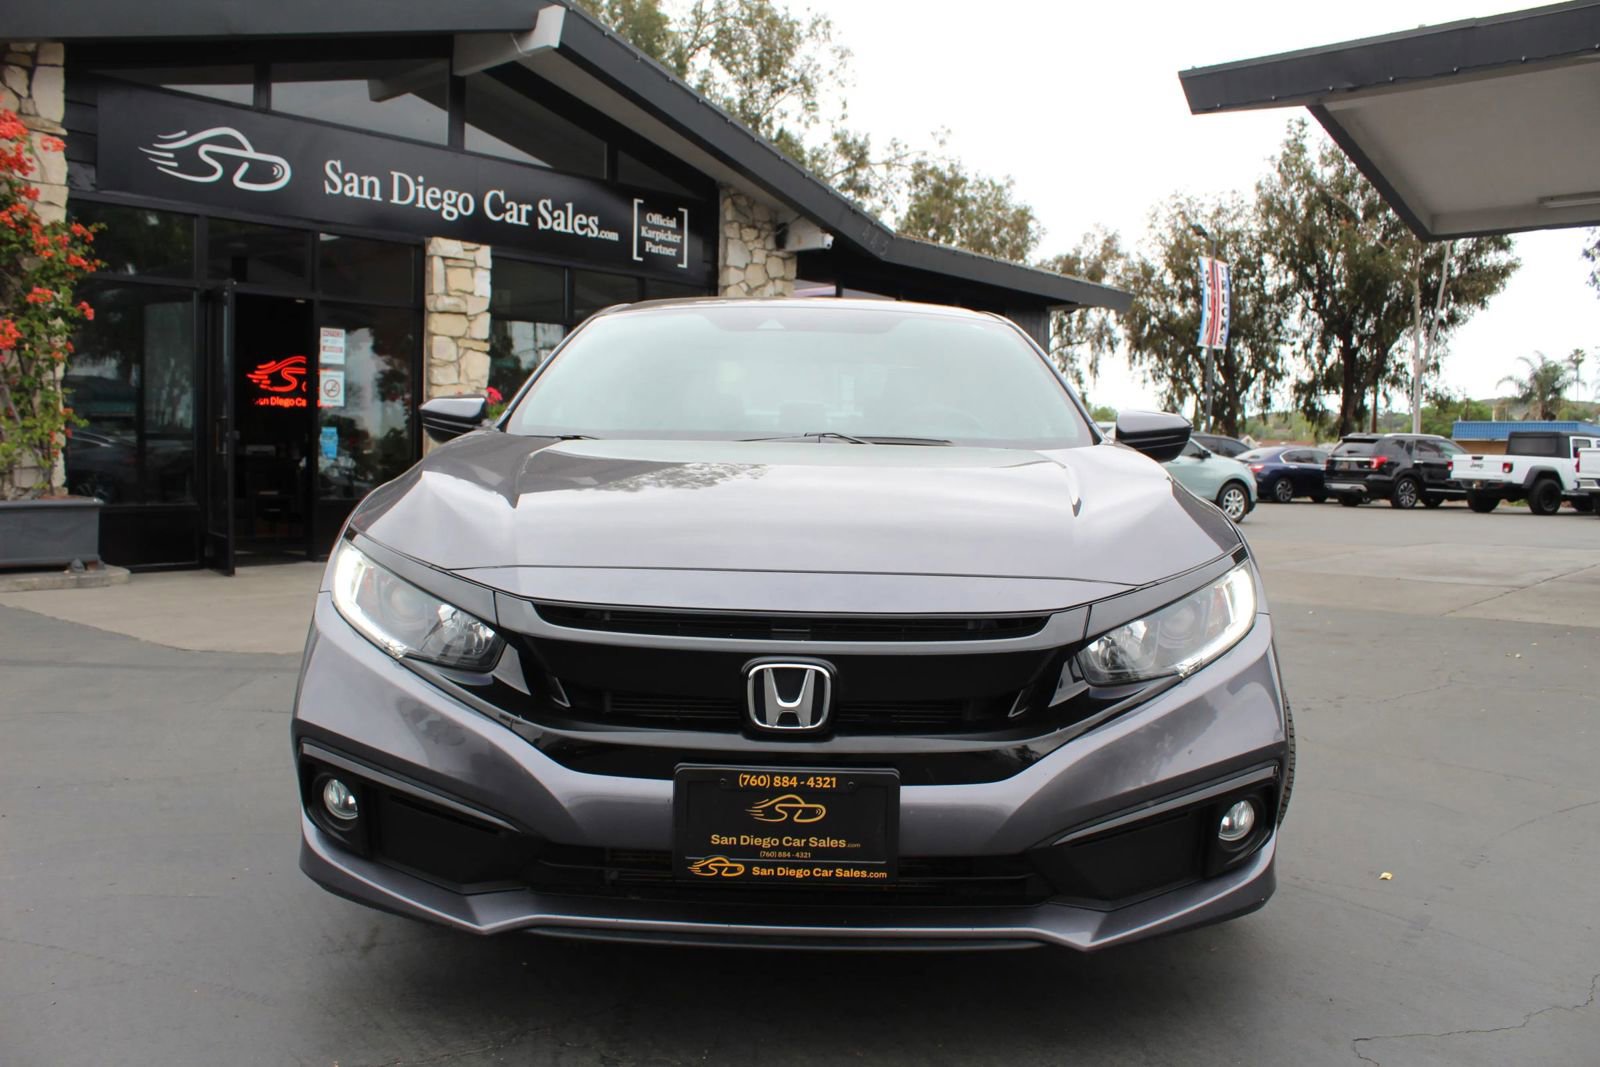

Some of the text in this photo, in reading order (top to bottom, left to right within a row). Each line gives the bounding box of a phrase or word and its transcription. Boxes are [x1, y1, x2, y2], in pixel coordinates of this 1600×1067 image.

[323, 159, 620, 242] San Diego Car Sales.com
[646, 212, 677, 229] Official
[645, 240, 677, 256] Partner
[270, 396, 295, 408] Diego
[738, 773, 771, 789] (760)
[773, 775, 798, 788] 884
[806, 776, 837, 788] 4321
[710, 834, 737, 846] San
[740, 835, 780, 848] Diego
[782, 836, 807, 847] Car
[759, 850, 777, 858] (760)
[752, 866, 887, 879] San Diego Car Sales.com
